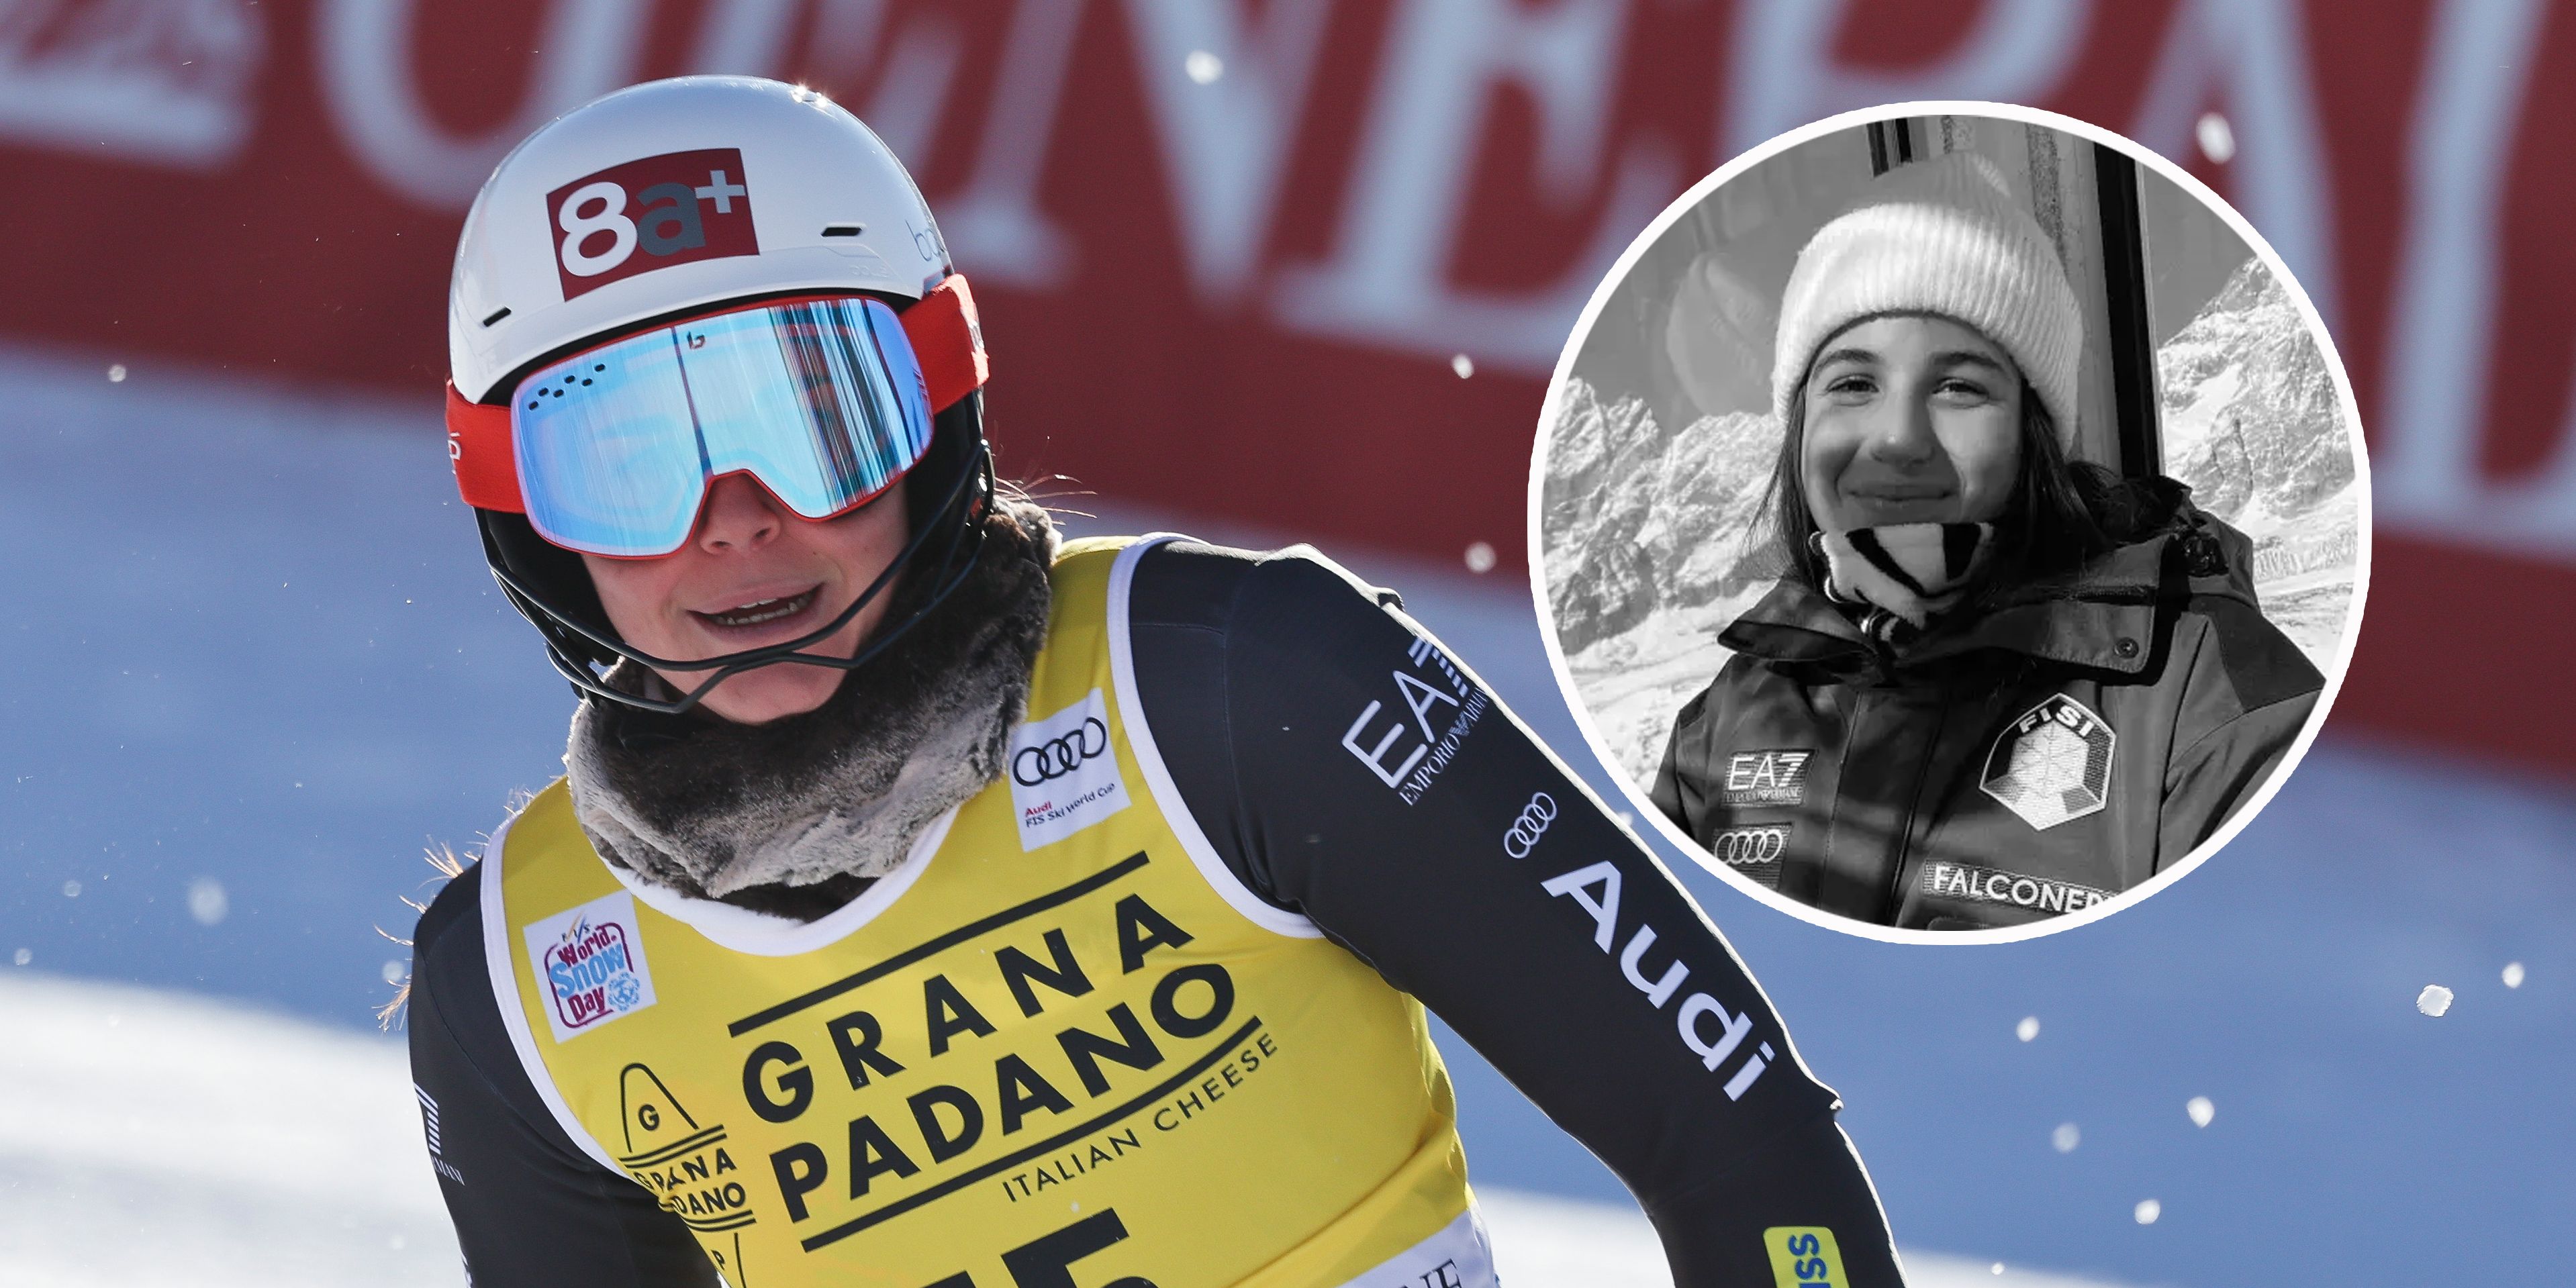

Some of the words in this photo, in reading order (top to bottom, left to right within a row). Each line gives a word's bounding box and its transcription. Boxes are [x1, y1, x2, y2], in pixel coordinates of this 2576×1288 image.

[559, 169, 746, 277] 8a+
[1341, 636, 1469, 789] EA7
[2018, 705, 2095, 738] FISI
[1398, 732, 1461, 807] EMPORIO
[1728, 752, 1809, 791] EA7
[1025, 801, 1053, 818] Audi
[1025, 815, 1045, 828] FIS
[568, 986, 606, 1022] Day
[743, 893, 1195, 1124] GRANA
[1541, 860, 1775, 1102] Audi
[638, 1104, 661, 1132] G
[769, 963, 1236, 1224] PADANO
[1002, 1128, 1141, 1202] ITALIAN
[1153, 1033, 1278, 1132] CHEESE
[671, 1181, 746, 1216] DANO
